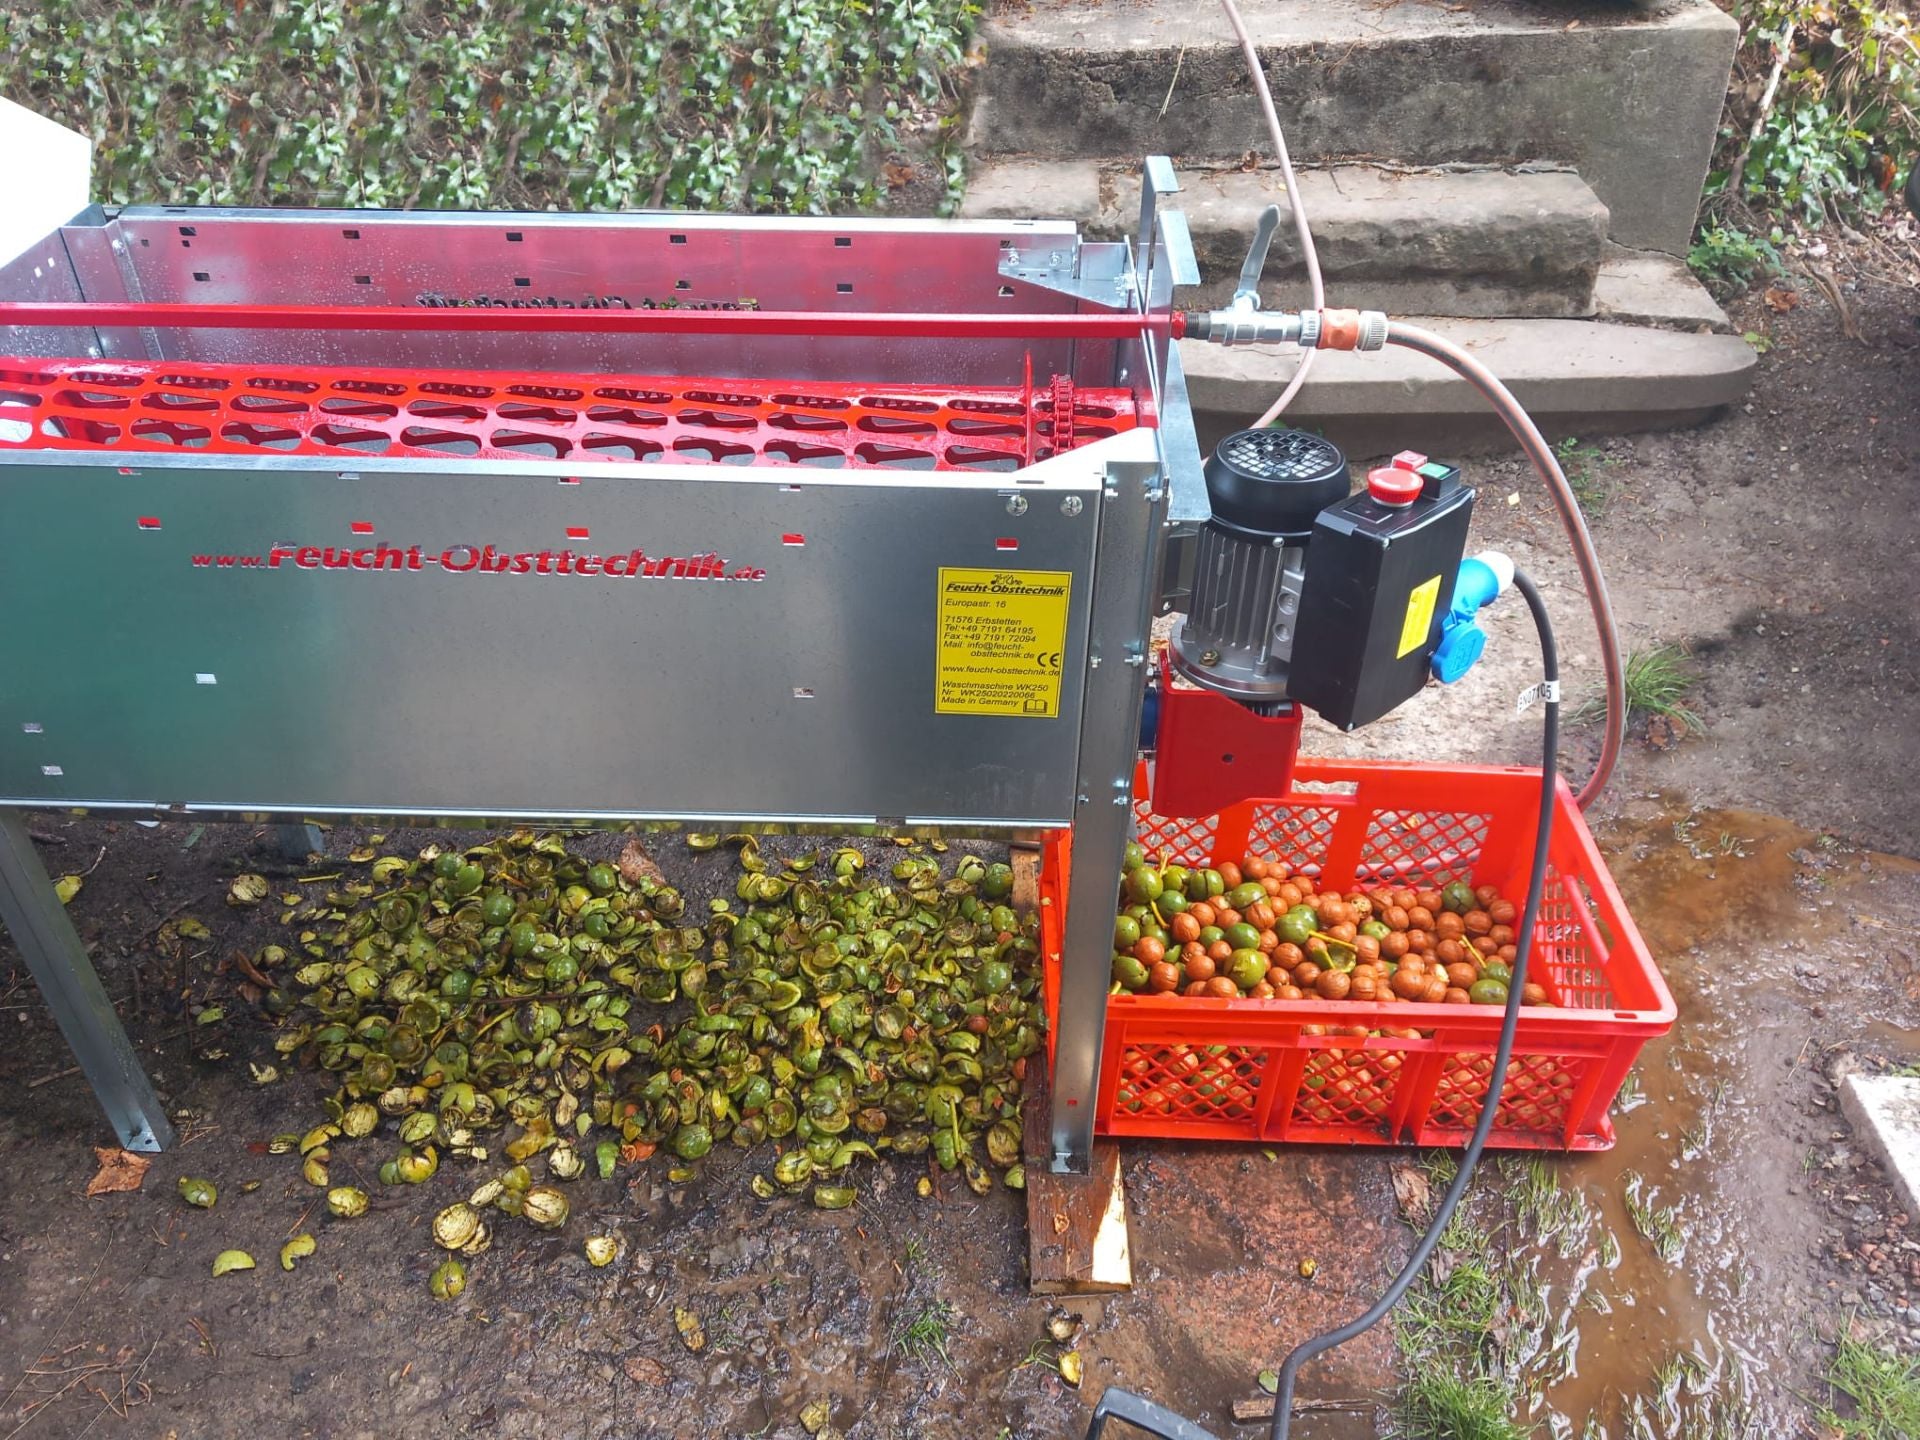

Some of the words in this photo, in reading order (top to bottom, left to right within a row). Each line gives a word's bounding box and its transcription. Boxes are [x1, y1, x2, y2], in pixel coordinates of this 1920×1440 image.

[191, 540, 766, 582] www.Feucht-Obsttechnik.de
[946, 584, 1065, 596] Feucht-Obsttechnik
[945, 599, 991, 608] Europastr.
[995, 600, 1006, 608] 16
[945, 615, 973, 624] 71576
[975, 617, 1022, 625] Erbstetten
[981, 625, 1002, 633] 7191
[942, 666, 1060, 676] www.feucht-obsttechnik.de
[942, 681, 1014, 690] Waschmaschine
[978, 698, 1018, 707] Germany
